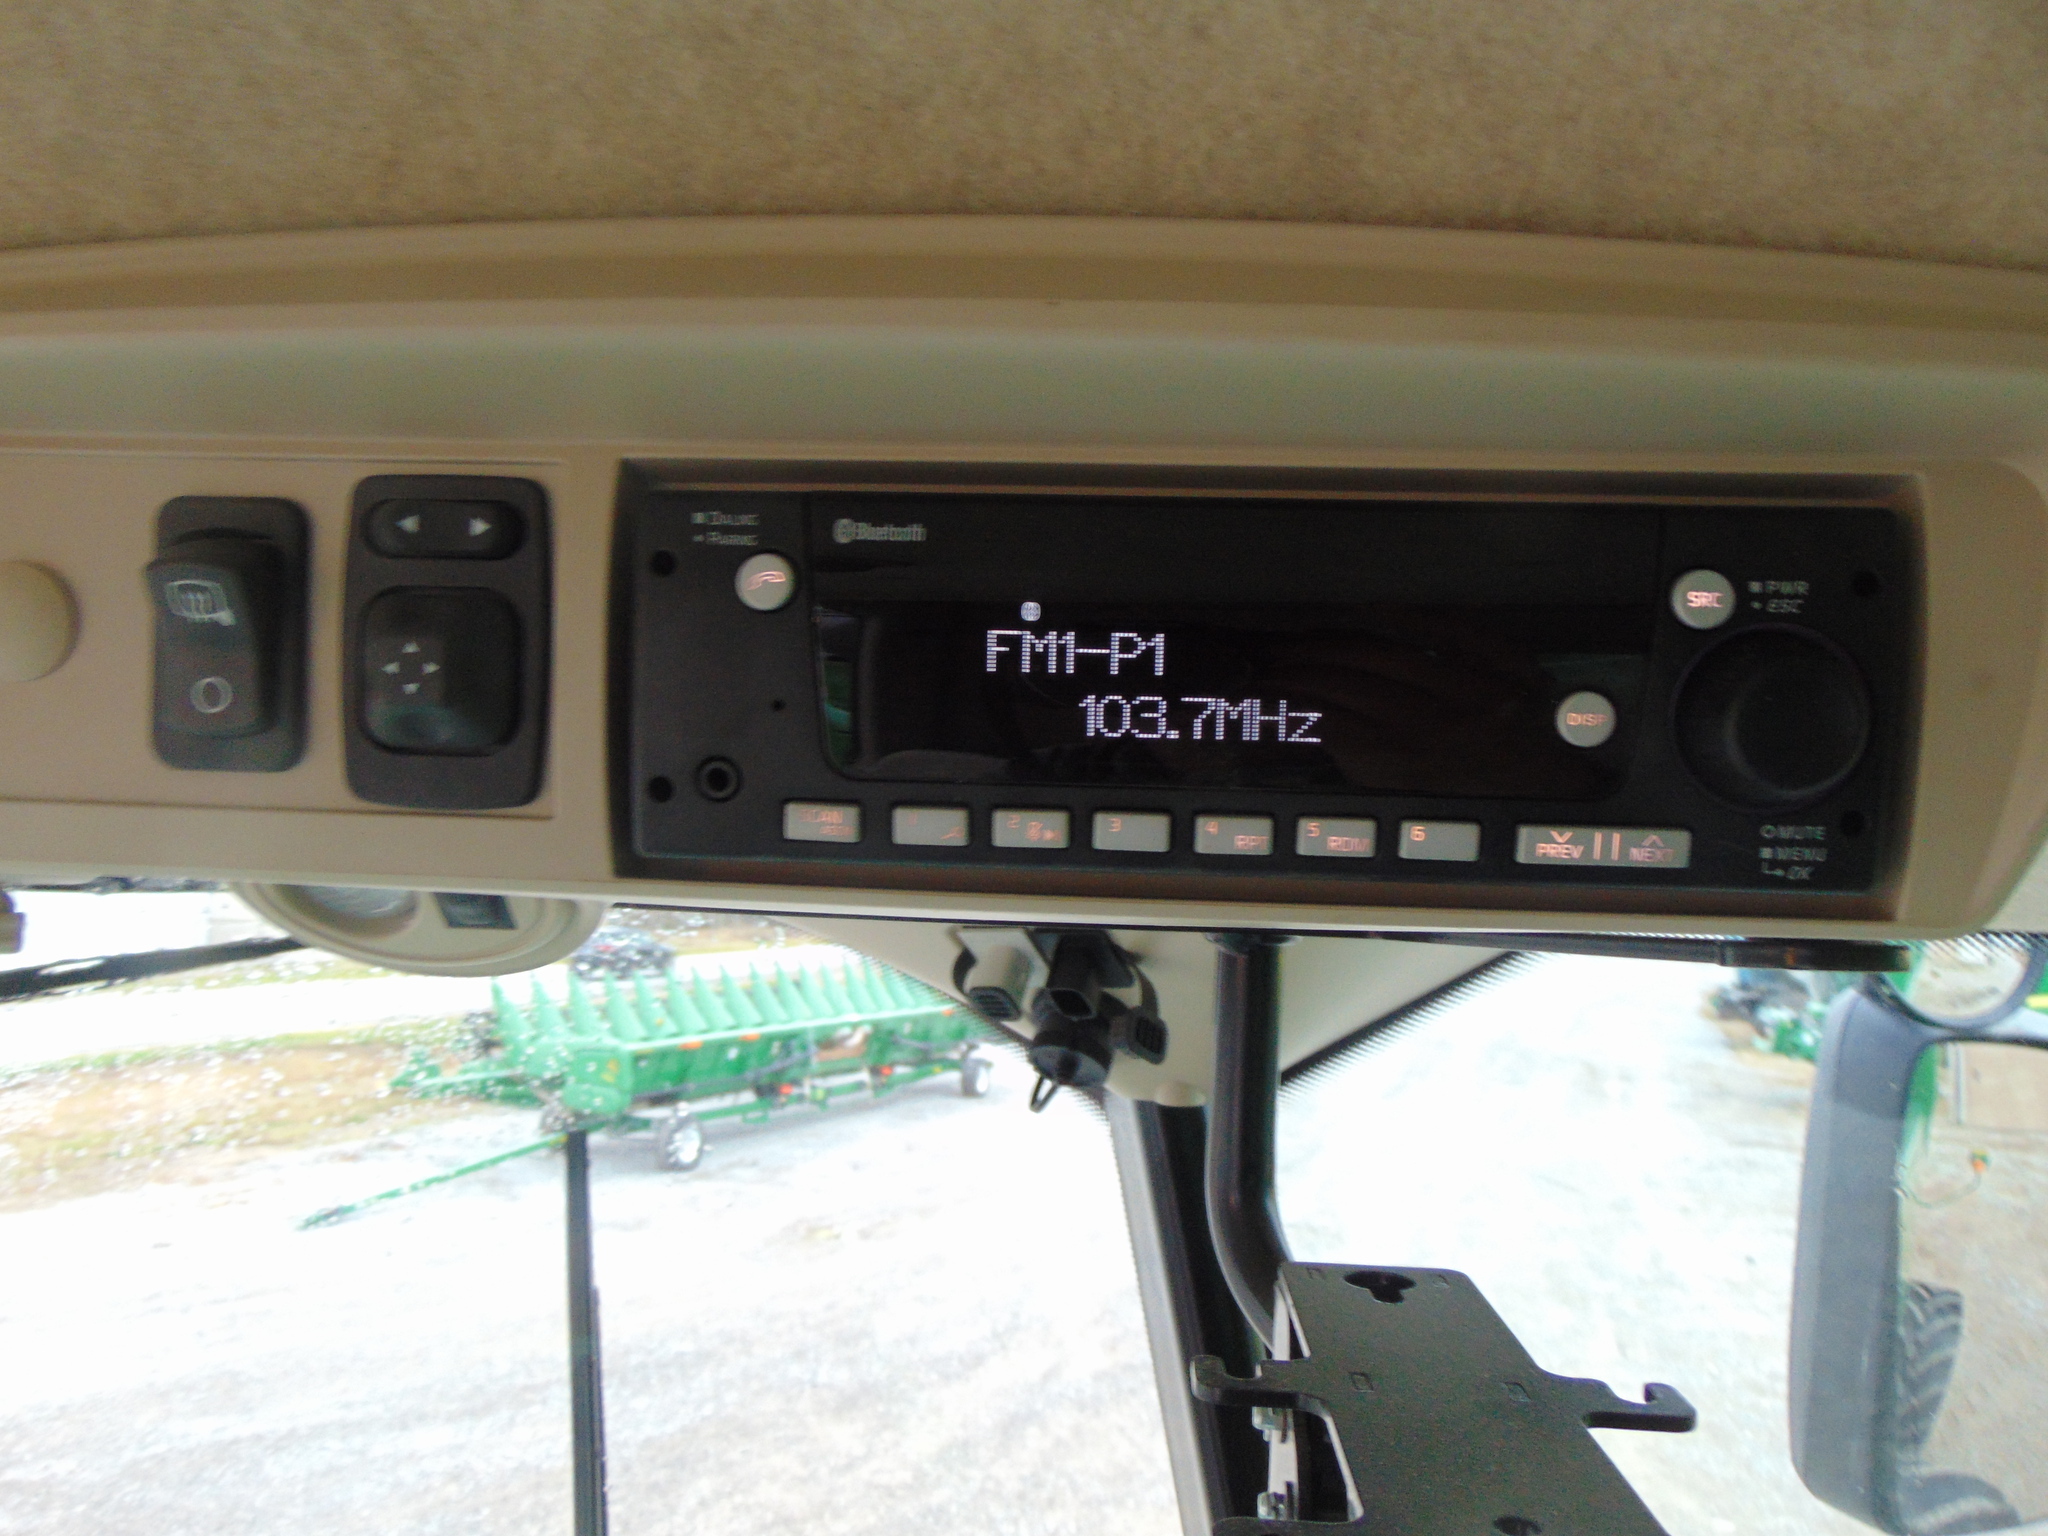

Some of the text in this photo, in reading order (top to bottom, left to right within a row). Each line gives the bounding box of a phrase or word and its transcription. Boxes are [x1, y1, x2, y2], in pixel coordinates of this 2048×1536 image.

[986, 630, 1165, 675] FM1-P1
[1079, 695, 1322, 743] 103.7MHz
[1007, 814, 1021, 829] 2
[1108, 818, 1122, 832] 3
[1204, 821, 1219, 836] 4
[1307, 822, 1321, 838] 5
[1410, 826, 1426, 841] 6
[1234, 835, 1270, 850] RPT
[1327, 836, 1371, 853] RDM
[1536, 843, 1584, 859] PREV
